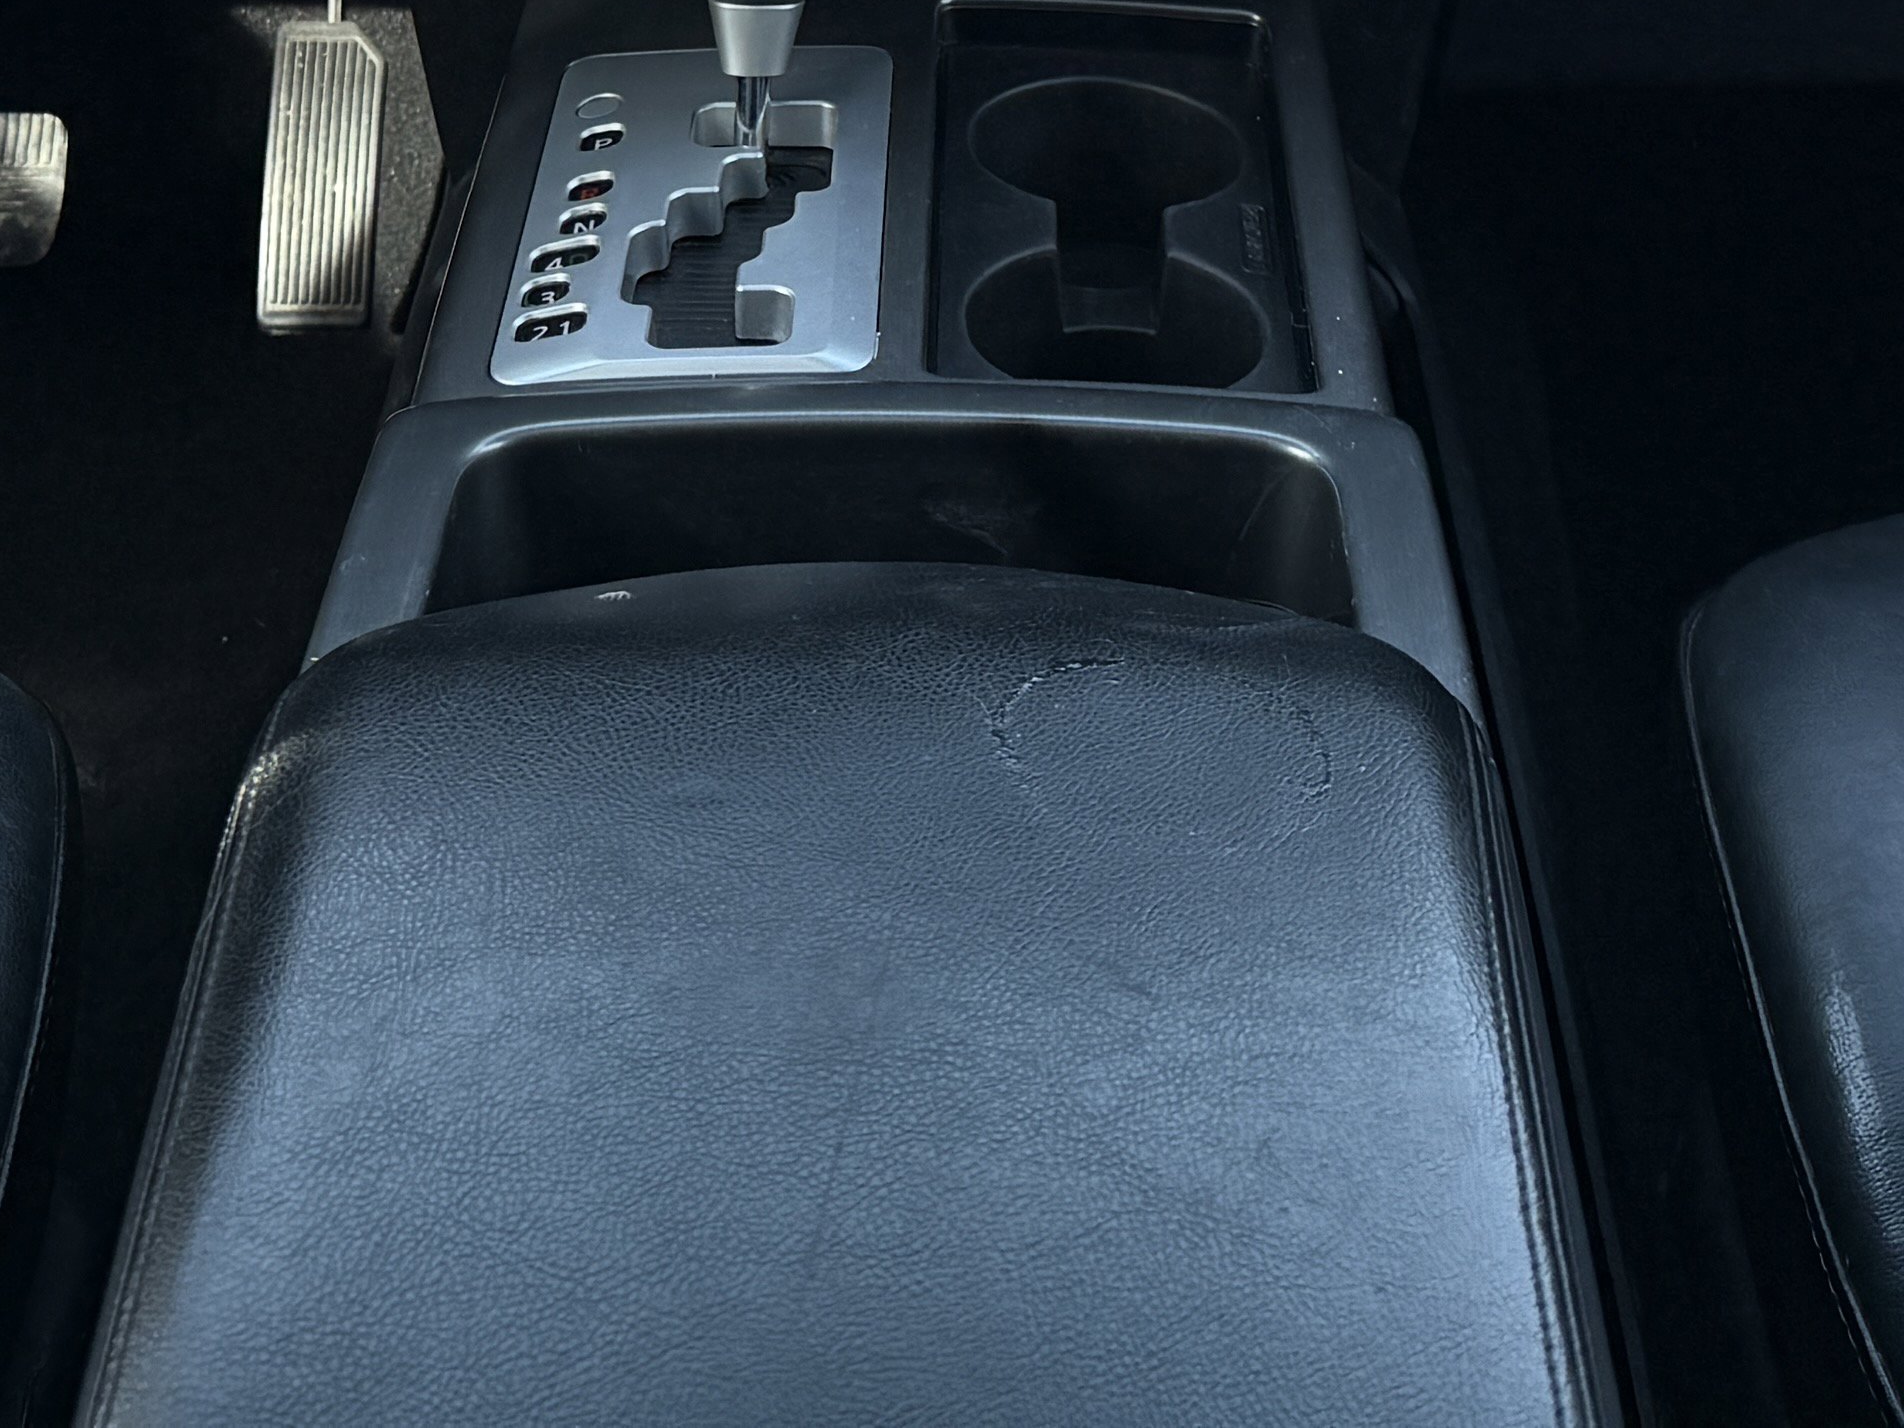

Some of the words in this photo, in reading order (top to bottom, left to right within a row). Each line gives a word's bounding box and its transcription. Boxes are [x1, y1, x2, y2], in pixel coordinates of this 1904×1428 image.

[594, 137, 613, 151] P
[573, 219, 595, 234] N
[544, 256, 564, 271] 4
[540, 291, 556, 305] 3
[530, 326, 549, 342] 2
[559, 320, 571, 336] 1
